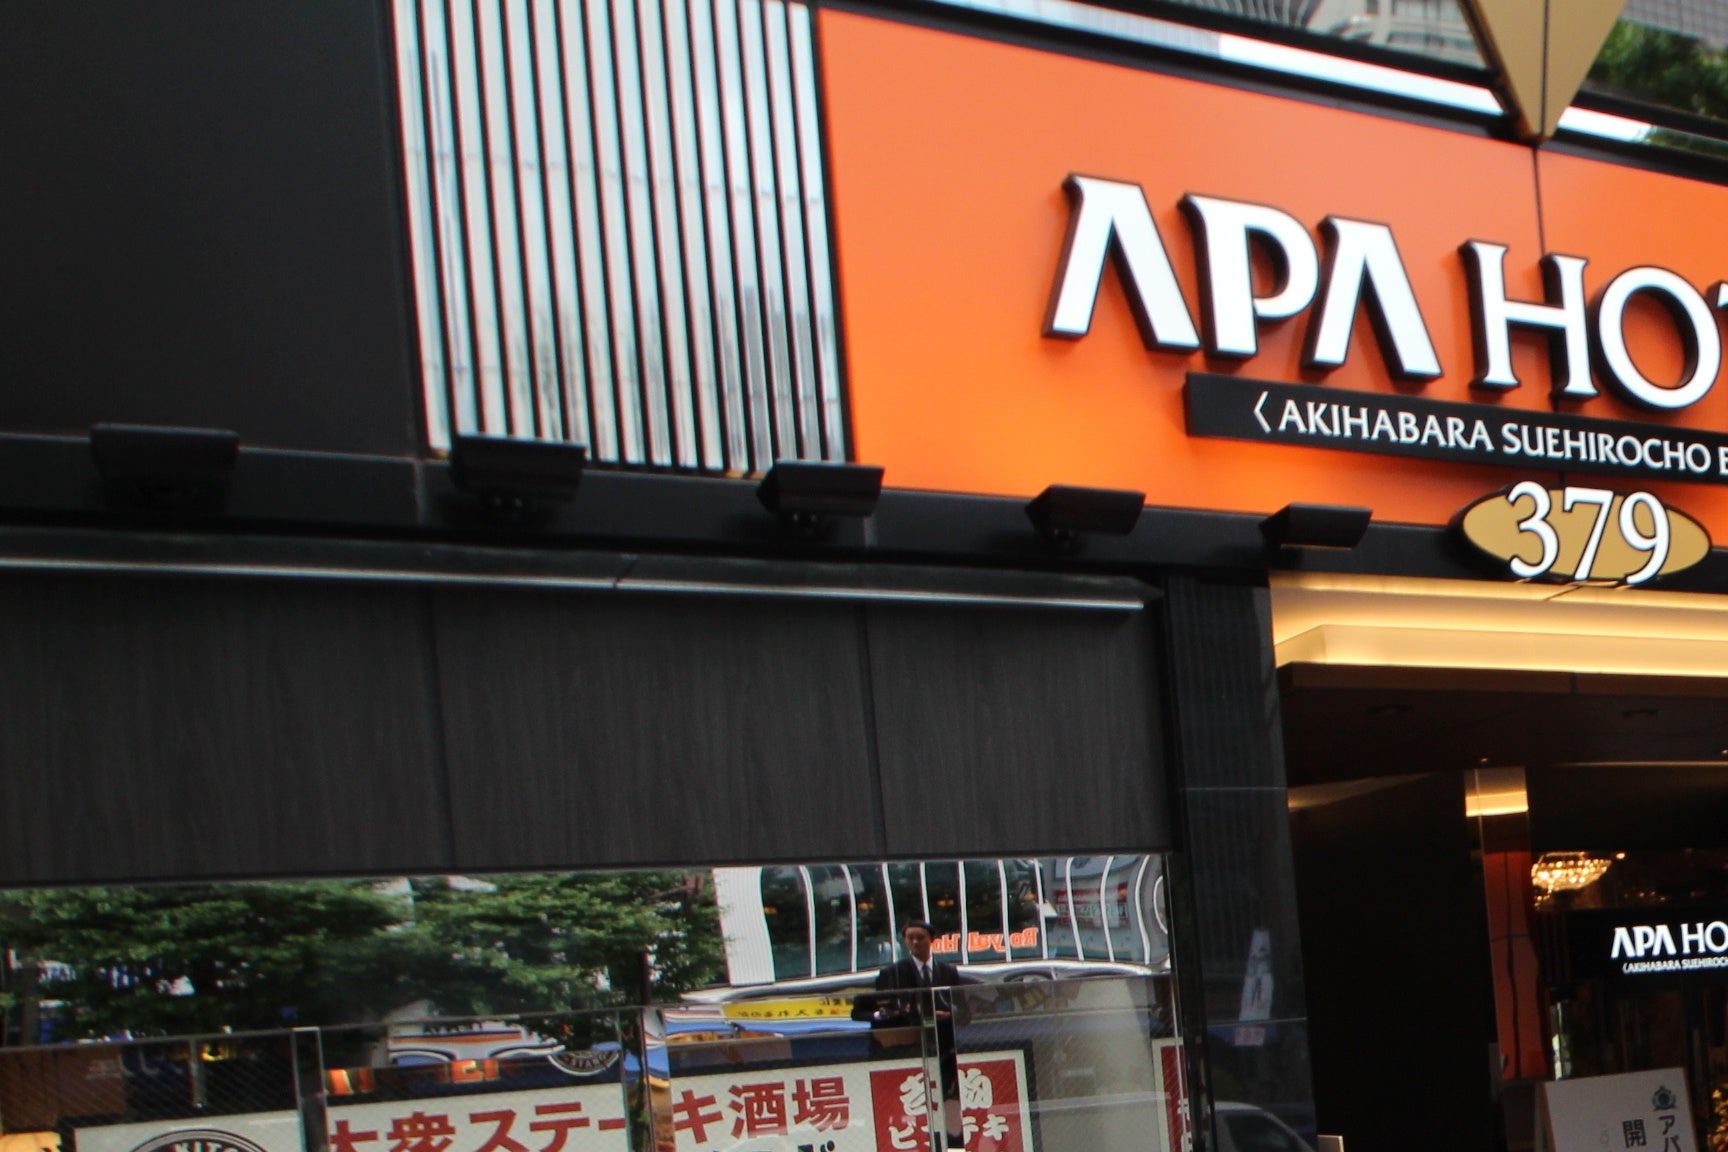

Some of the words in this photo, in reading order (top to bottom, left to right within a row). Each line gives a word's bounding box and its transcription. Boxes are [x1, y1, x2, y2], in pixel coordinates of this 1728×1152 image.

[1045, 174, 1441, 379] APA
[1501, 421, 1711, 473] SUEHIROCHO
[1507, 481, 1671, 588] 379
[1610, 925, 1677, 960] APA
